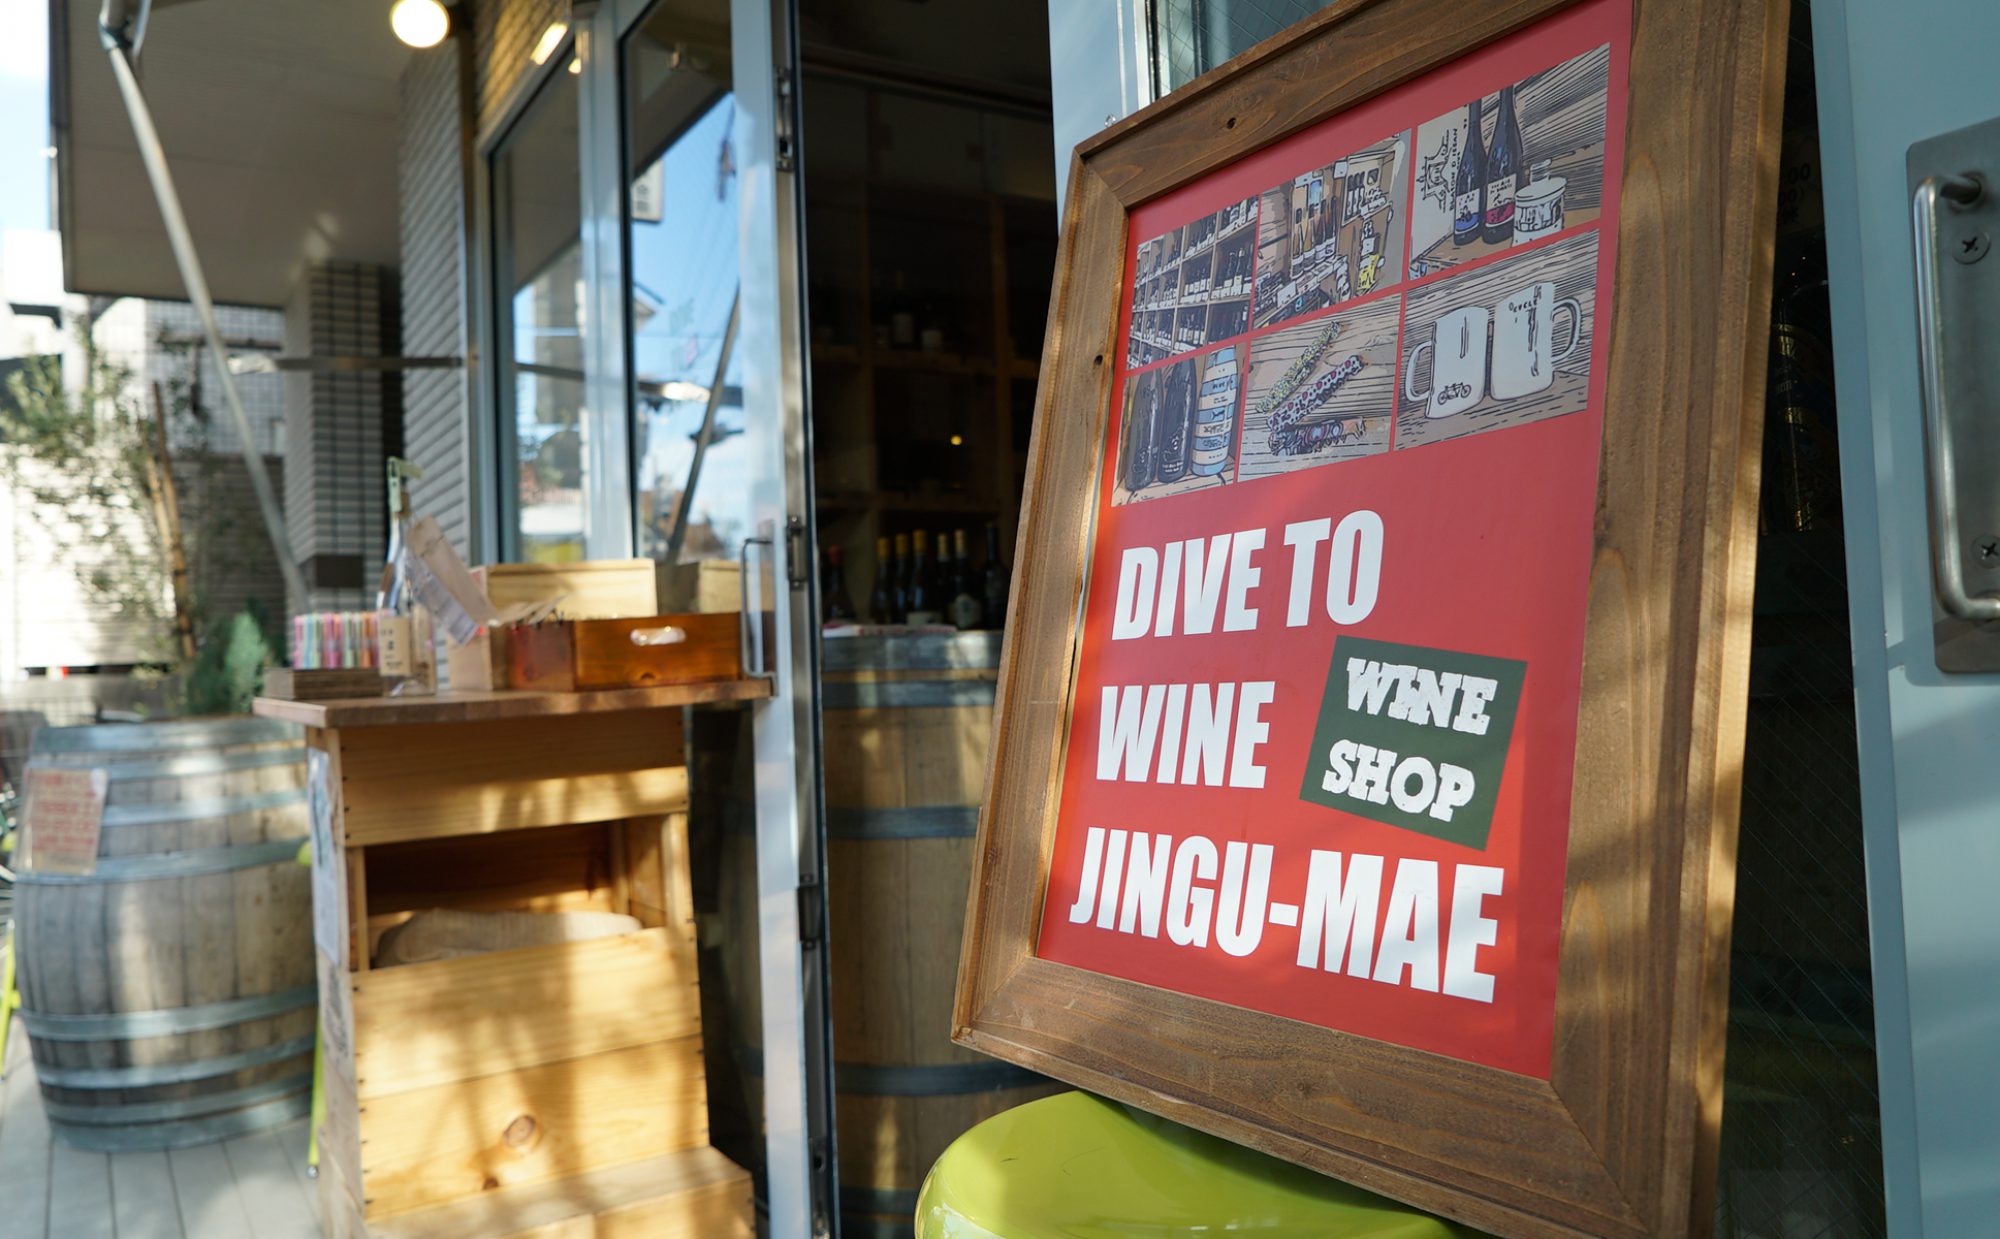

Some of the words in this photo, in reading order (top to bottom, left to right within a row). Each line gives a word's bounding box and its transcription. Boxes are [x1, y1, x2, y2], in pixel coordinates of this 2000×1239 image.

[1112, 527, 1267, 641] DIVE
[1283, 509, 1385, 628] TO
[1095, 680, 1276, 789] WINE
[1345, 656, 1499, 736] WINE
[1321, 738, 1476, 823] SHOP
[1068, 826, 1505, 1004] JINGU-MAE
